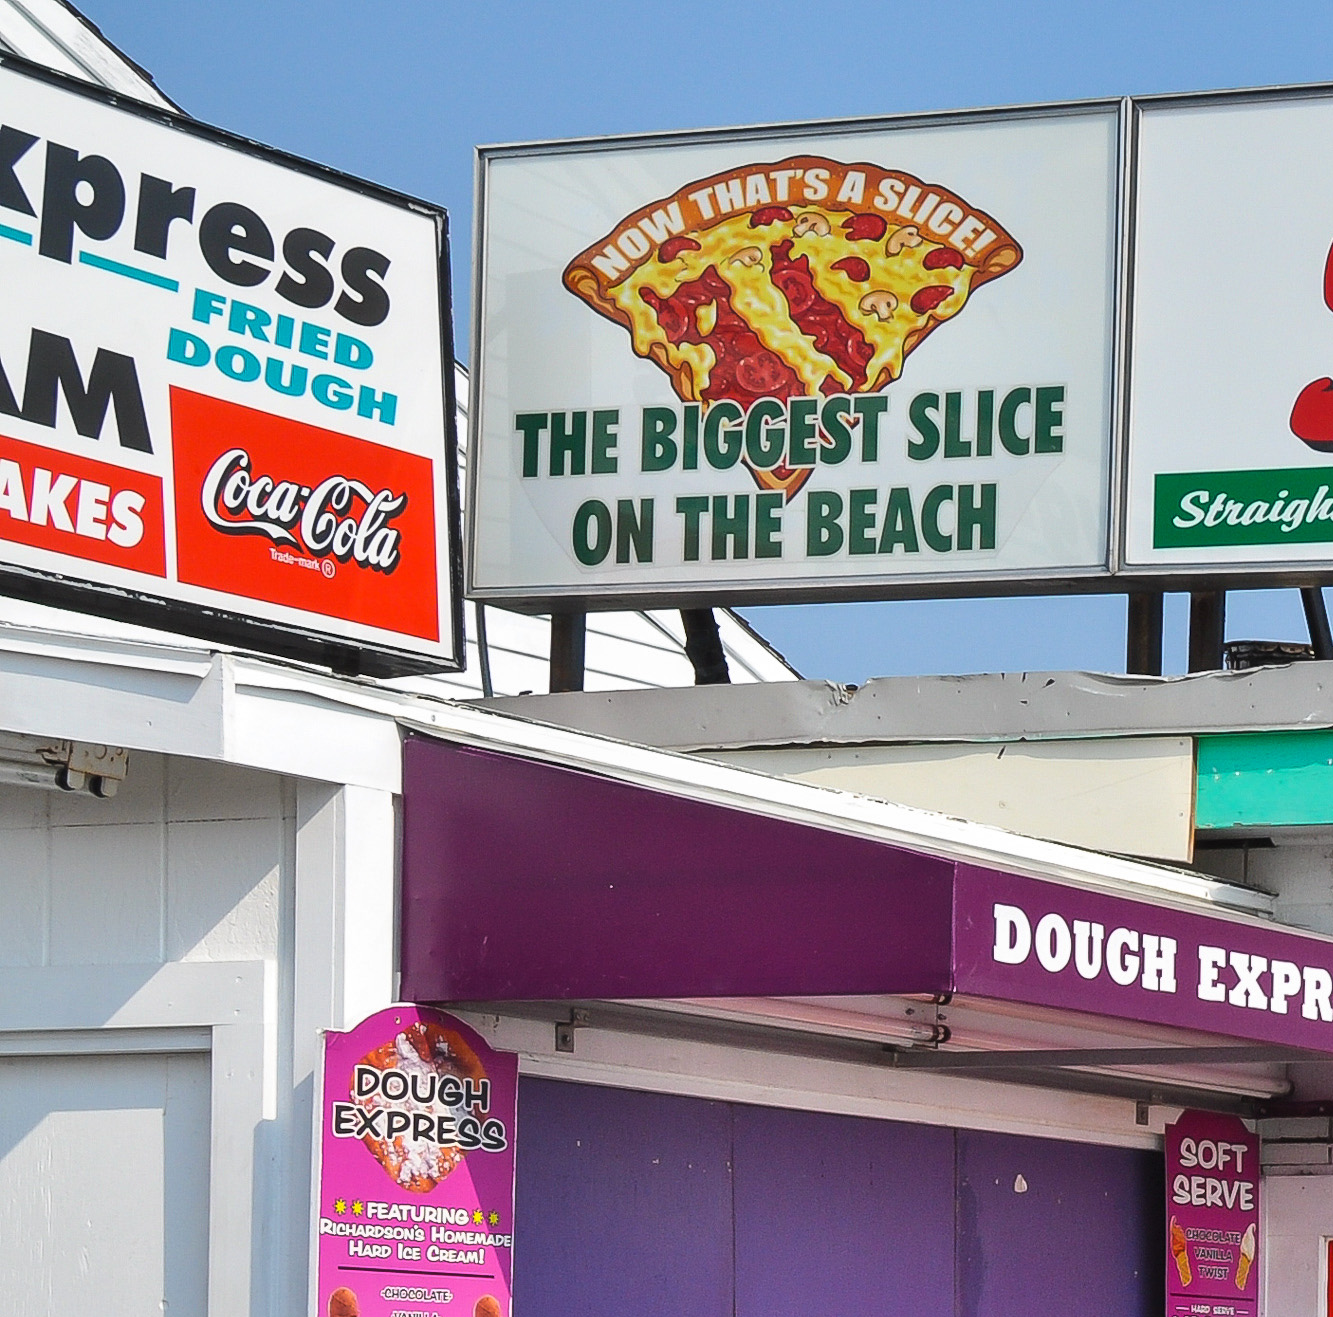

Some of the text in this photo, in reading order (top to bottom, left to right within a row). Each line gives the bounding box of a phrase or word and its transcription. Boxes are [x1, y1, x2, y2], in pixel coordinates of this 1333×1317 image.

[591, 167, 996, 279] NOW THAT'S A SLICE!
[192, 288, 374, 370] FRIED
[166, 328, 397, 426] DOUGH
[515, 386, 1065, 477] THE BIGGEST SLICE
[202, 449, 406, 570] Coca-Cola
[572, 483, 997, 565] ON THE BEACH
[993, 903, 1177, 993] DOUGH
[333, 1102, 507, 1152] EXPRESS
[355, 1065, 490, 1113] DOUGH
[1172, 1174, 1254, 1211] SERVE
[1179, 1138, 1247, 1172] SOFT
[366, 1202, 469, 1225] FEATURING
